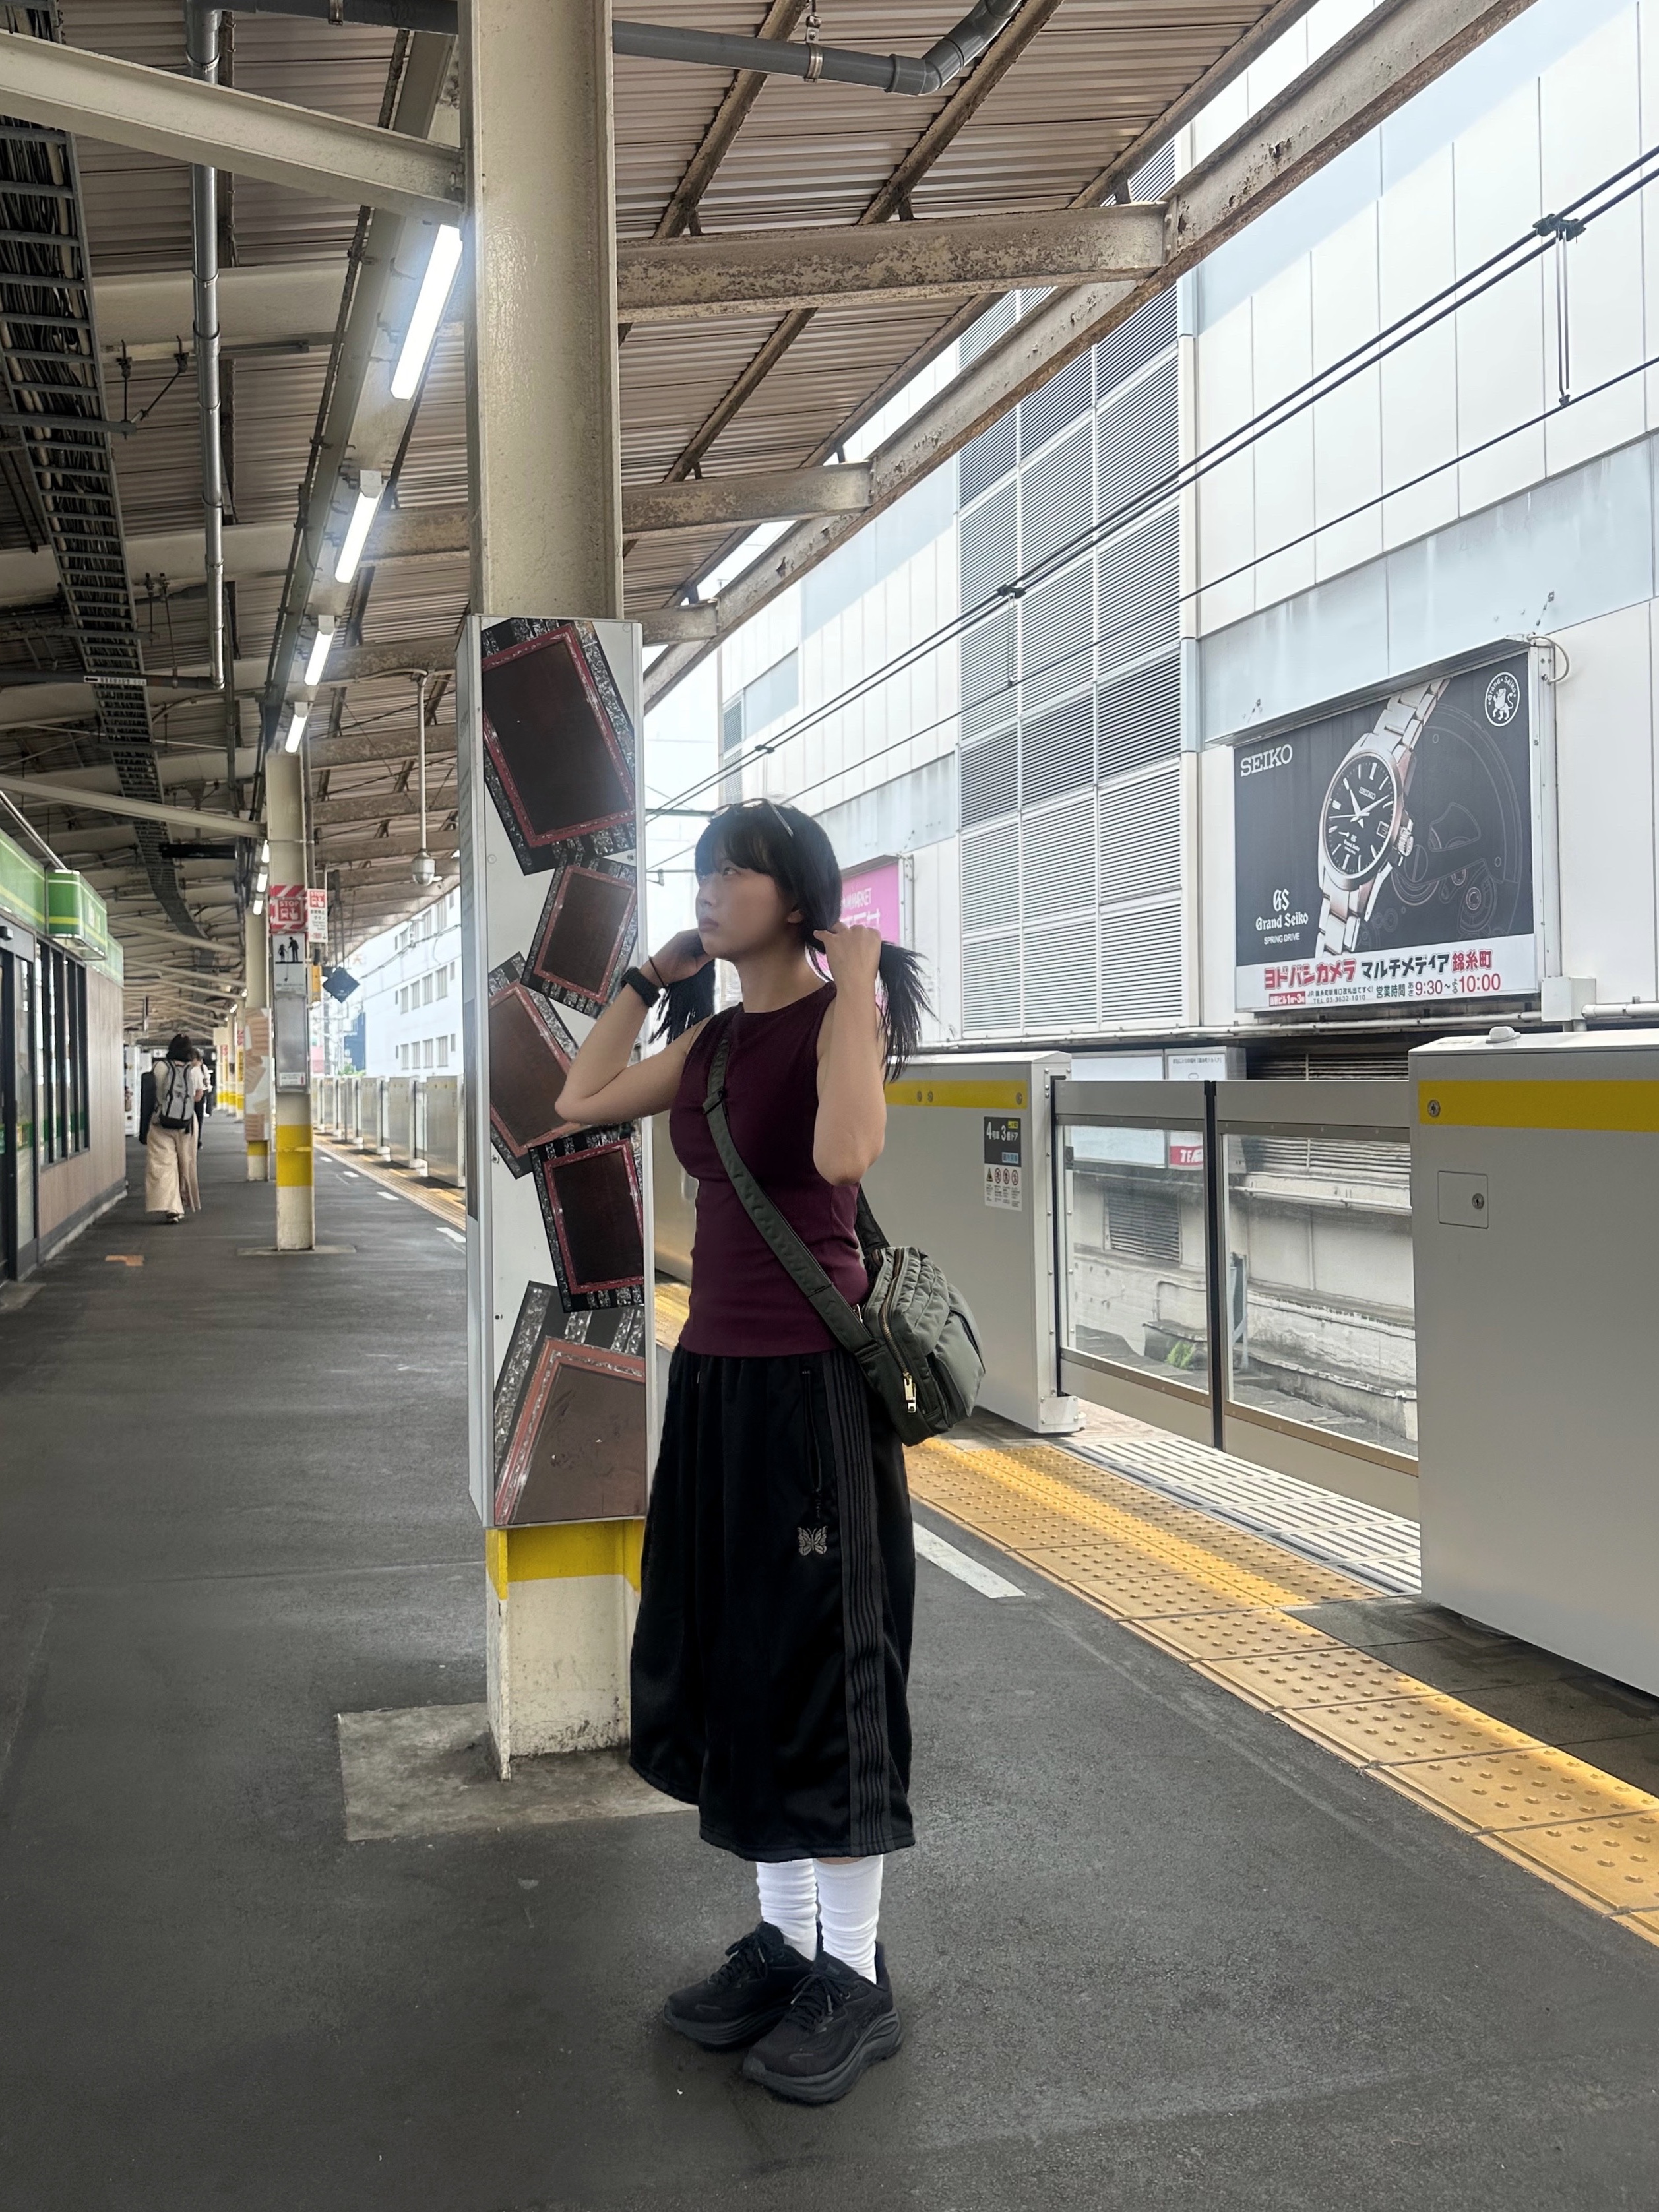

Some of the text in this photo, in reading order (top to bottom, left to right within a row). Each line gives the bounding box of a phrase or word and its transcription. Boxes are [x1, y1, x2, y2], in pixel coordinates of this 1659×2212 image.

[1240, 743, 1293, 777] SEIKO
[1272, 888, 1290, 912] GS
[1255, 911, 1309, 931] Grand Seiko
[1264, 932, 1301, 945] SPRING DRIVE
[1265, 959, 1356, 989] ヨドバシカメラ
[1376, 984, 1406, 998] 営業時間
[1458, 973, 1501, 994] 10:00
